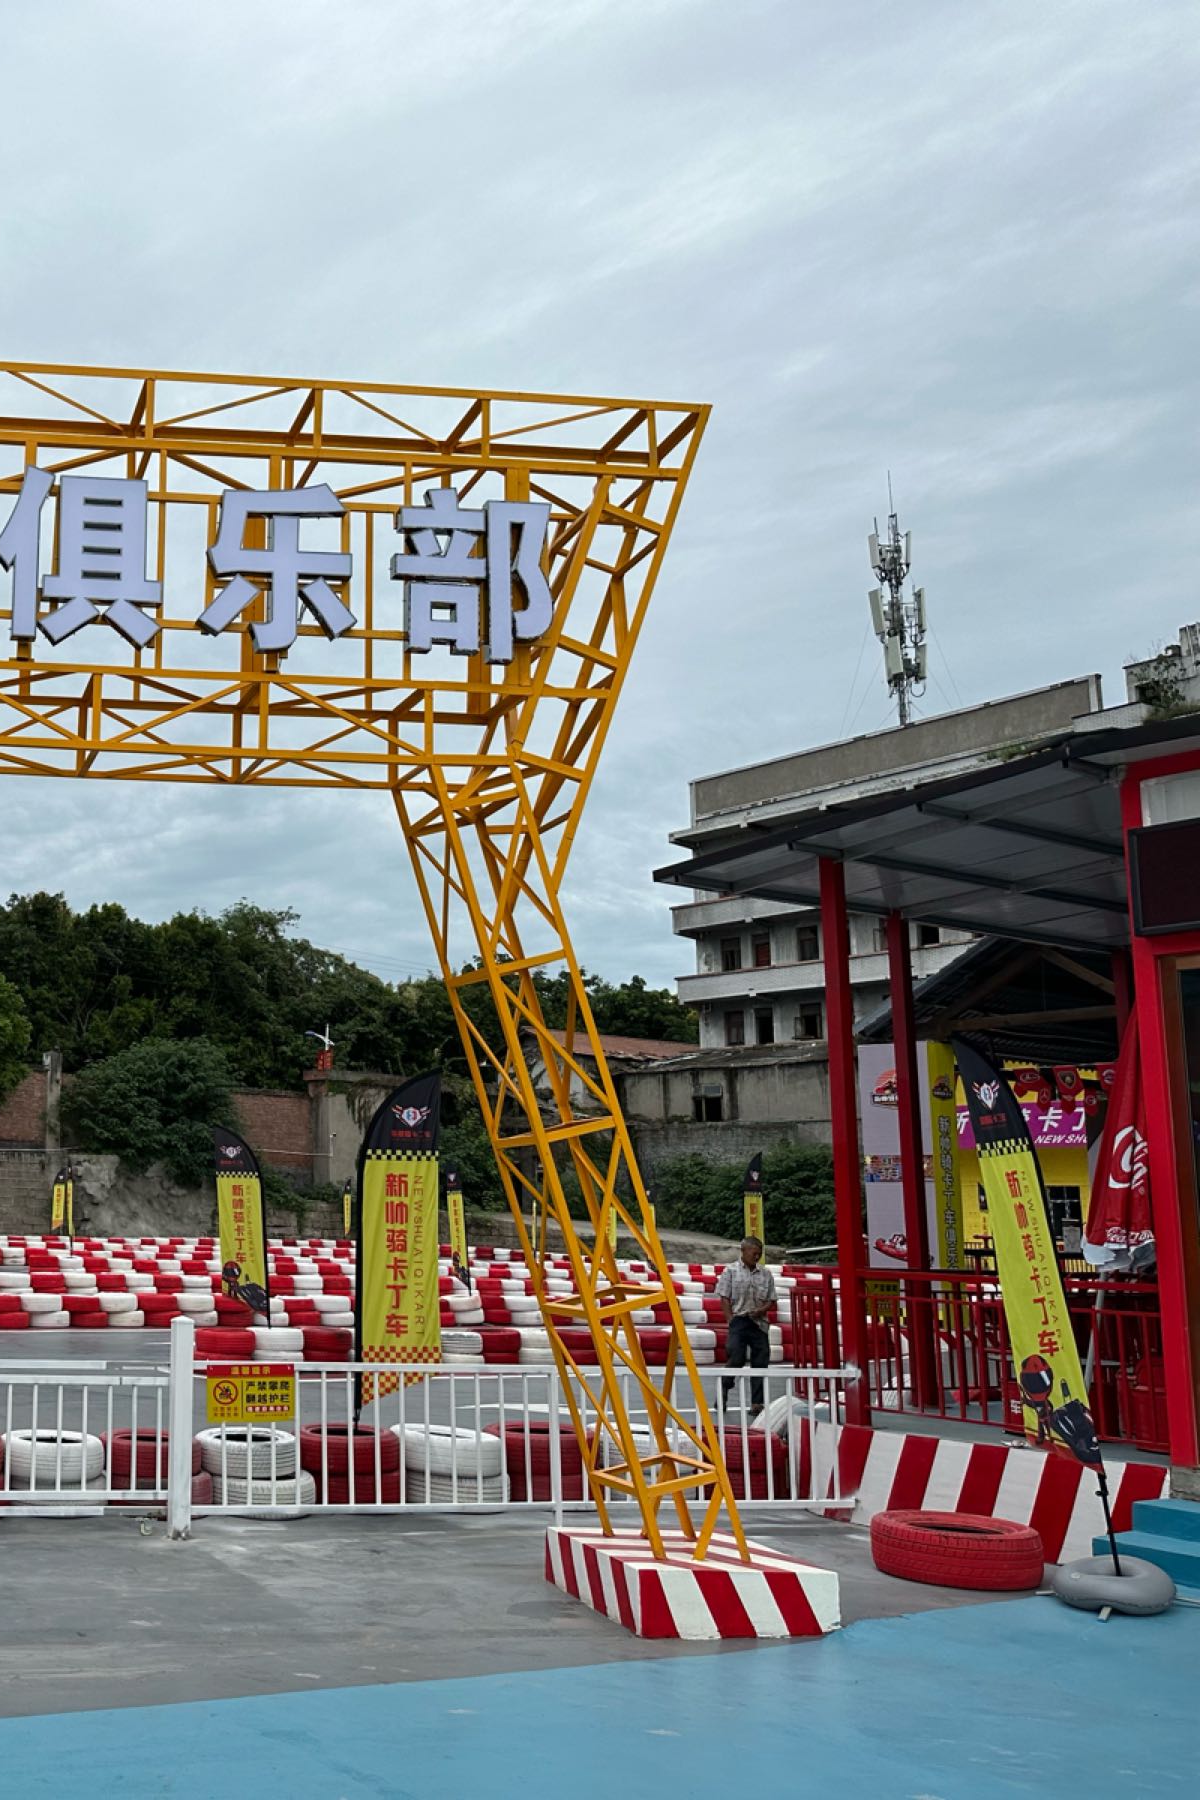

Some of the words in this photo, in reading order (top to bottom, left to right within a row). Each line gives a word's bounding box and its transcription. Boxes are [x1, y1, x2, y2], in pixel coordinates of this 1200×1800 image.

[385, 1172, 409, 1339] 新帅骑卡丁车
